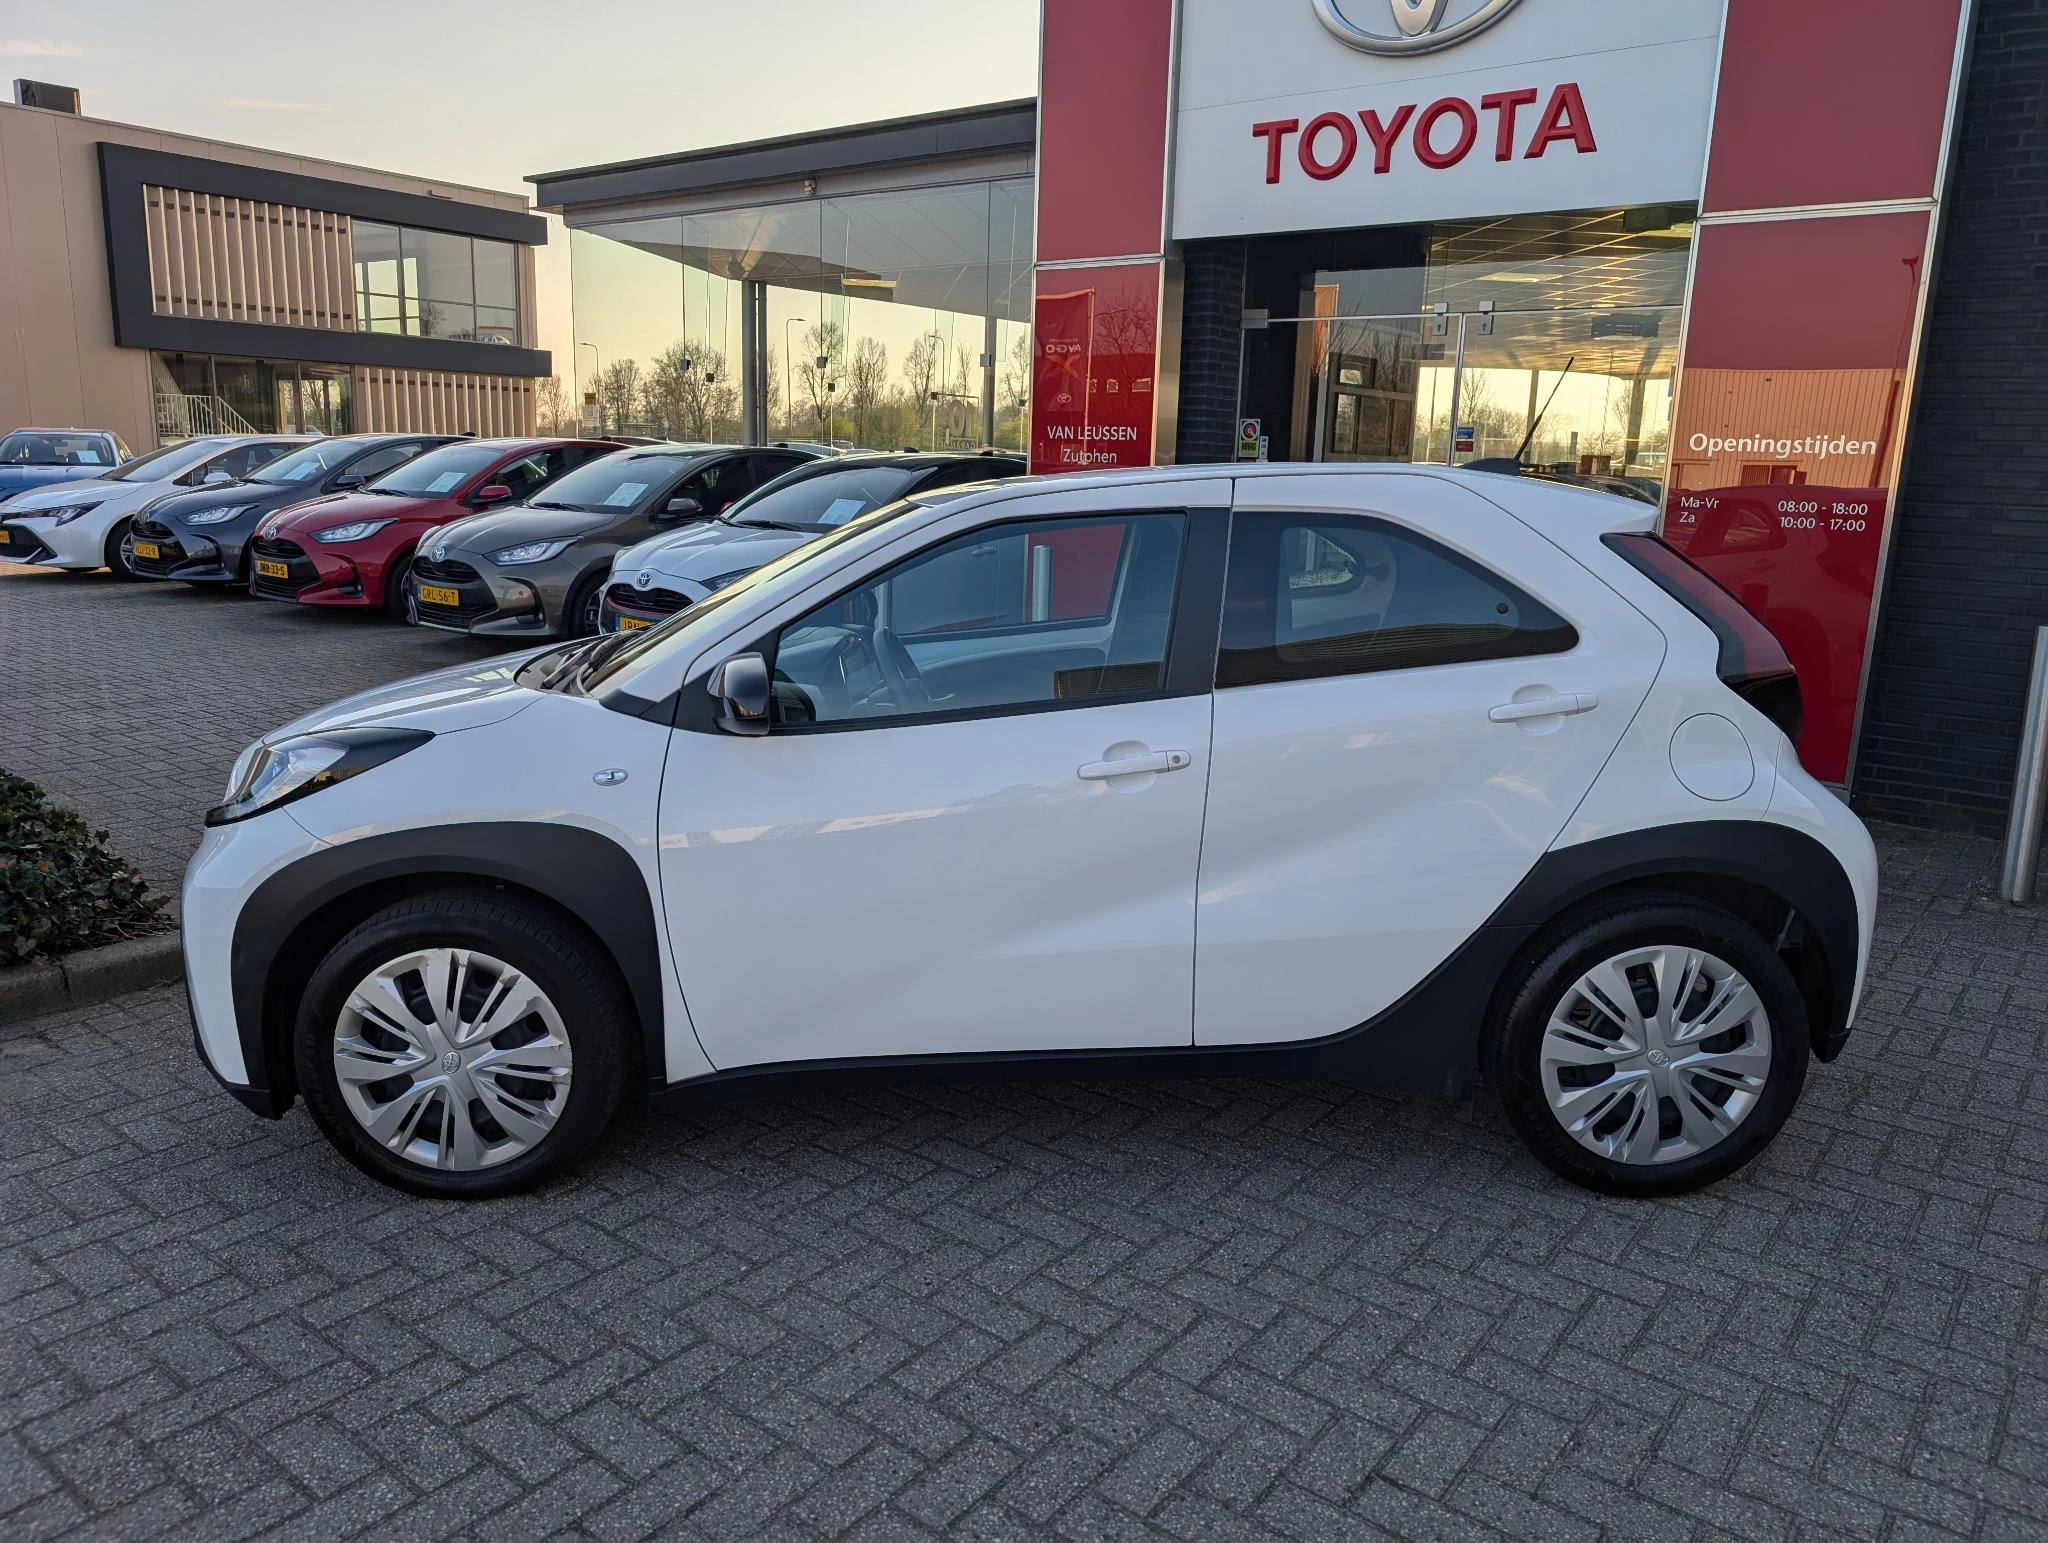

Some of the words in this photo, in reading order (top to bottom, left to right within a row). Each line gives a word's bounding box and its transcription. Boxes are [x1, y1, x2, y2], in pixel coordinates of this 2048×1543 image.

[1252, 82, 1598, 184] TOYOTA
[1047, 425, 1074, 440] VAN
[1077, 425, 1137, 441] LEUSSEN
[1689, 432, 1877, 460] Openingstijden
[1063, 448, 1117, 465] Zutphen
[1680, 496, 1720, 510] Ma-Vr
[1778, 500, 1818, 513] 08:00
[1831, 502, 1868, 516] 18:00
[1679, 511, 1695, 523] Za
[1779, 516, 1816, 529] 10:00
[1829, 519, 1866, 532] 17:00
[422, 587, 456, 603] GRL-56-T
